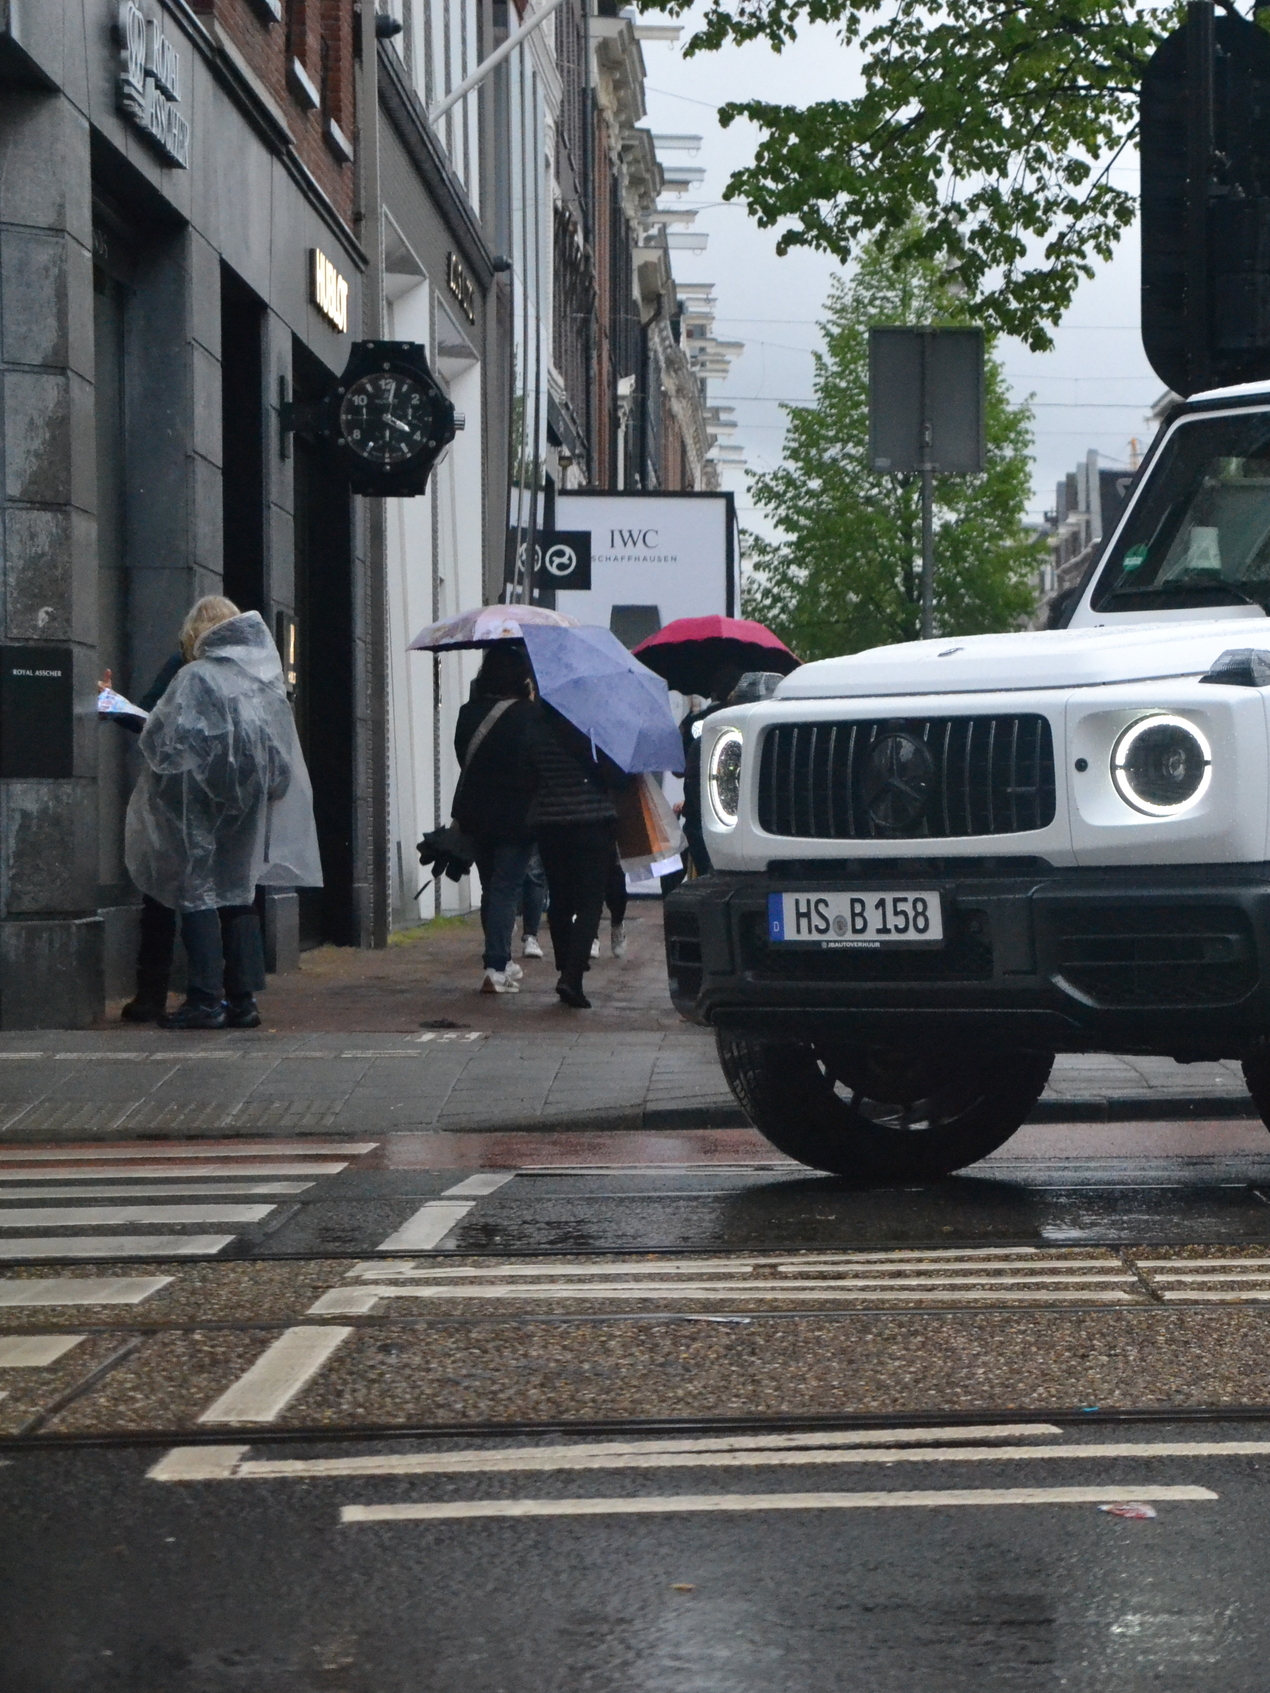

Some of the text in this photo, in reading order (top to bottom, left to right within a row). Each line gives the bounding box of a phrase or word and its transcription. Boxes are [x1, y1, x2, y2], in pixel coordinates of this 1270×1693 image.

[316, 248, 348, 333] HUBLOT
[352, 395, 367, 405] 10
[411, 394, 420, 404] 2
[610, 528, 659, 549] IWC
[591, 555, 677, 563] SCHAFFHAUSEN
[794, 898, 830, 935] HS
[773, 921, 780, 932] D
